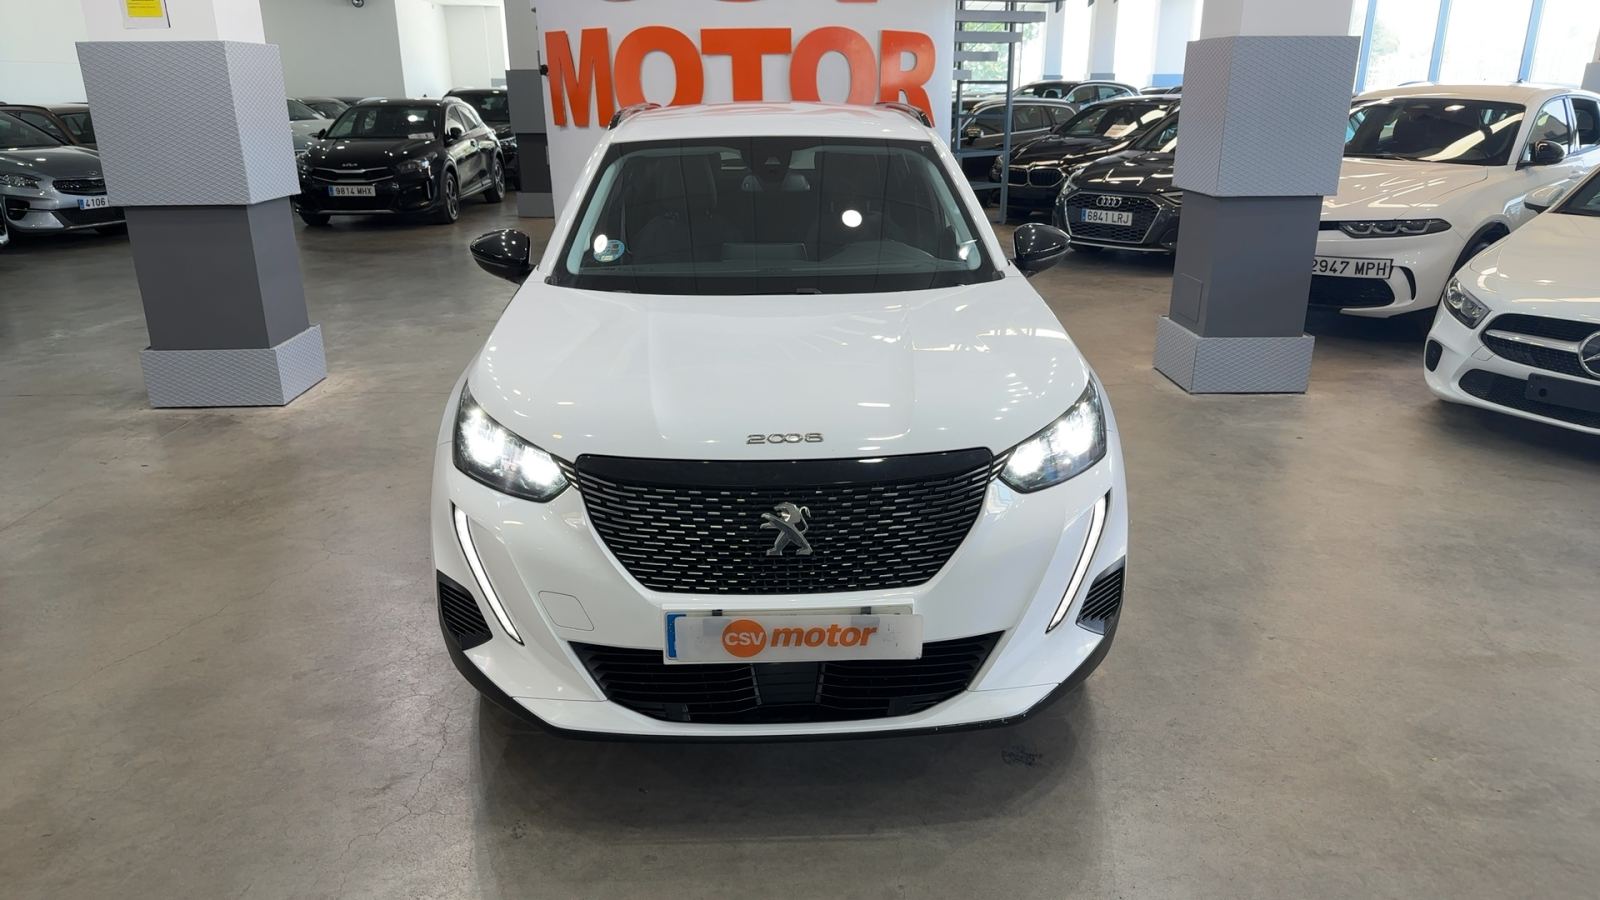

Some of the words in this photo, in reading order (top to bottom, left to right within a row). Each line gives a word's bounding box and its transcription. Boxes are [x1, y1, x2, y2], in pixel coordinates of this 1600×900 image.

[544, 25, 936, 128] MOTOR
[335, 186, 355, 195] 9814
[356, 186, 373, 195] MHX
[85, 197, 106, 207] 4106
[1087, 210, 1109, 222] 6841
[1111, 212, 1130, 224] LRJ
[1311, 259, 1350, 274] 2947
[1354, 261, 1387, 276] MPH
[746, 432, 824, 445] 2008
[770, 624, 880, 648] motor
